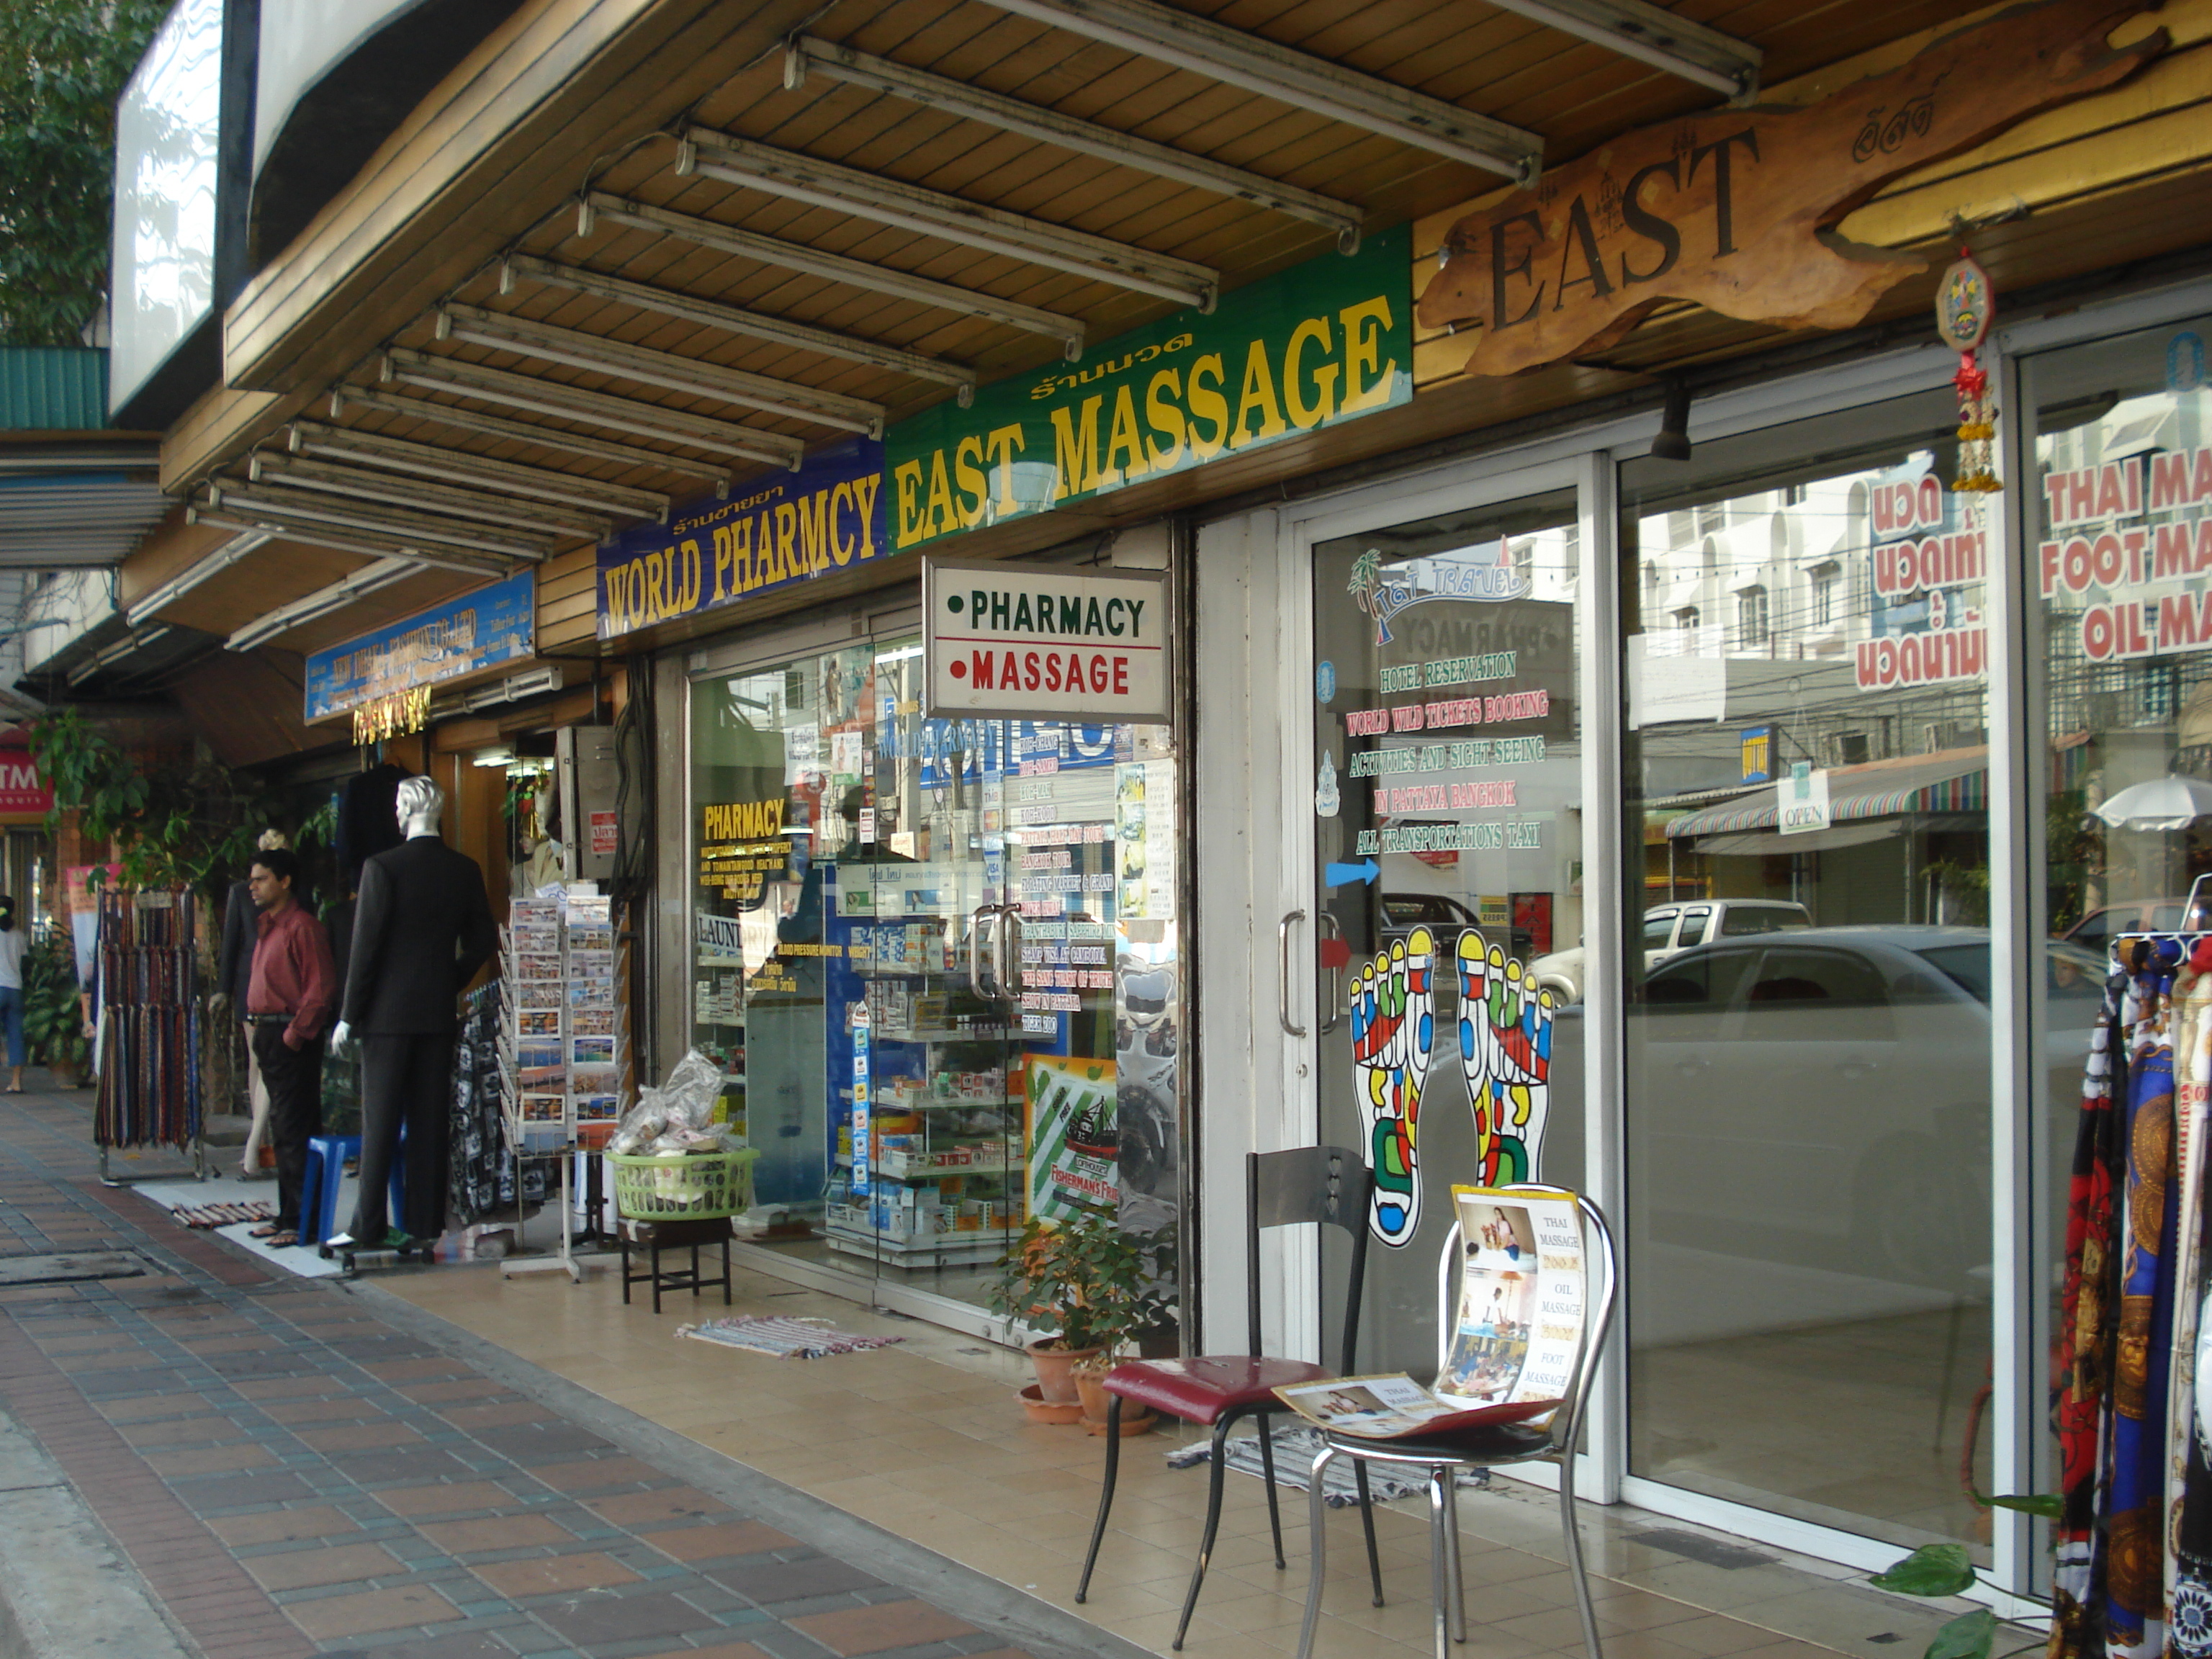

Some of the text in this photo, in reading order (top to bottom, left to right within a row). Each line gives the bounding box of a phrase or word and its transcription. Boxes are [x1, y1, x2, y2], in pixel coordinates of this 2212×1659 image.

[1489, 127, 1761, 331] EAST
[1030, 332, 1195, 401] ร้านนวด
[896, 295, 1397, 548] EAST MASSAGE
[672, 485, 784, 536] ร้านขายยา
[1873, 476, 1941, 533] นวด
[2046, 457, 2141, 527] THAI
[605, 538, 701, 639] WORLD
[713, 472, 881, 601] PHARMCY
[2040, 526, 2149, 599] FOOT
[1432, 566, 1524, 595] TRAVEL
[971, 590, 1145, 638] PHARMACY
[2082, 601, 2155, 661] OIL
[972, 649, 1129, 695] MASSAGE
[1380, 651, 1517, 694] HOTEL RESERVATION
[1346, 709, 1389, 738] WORLD
[1392, 706, 1424, 733] WILD
[1426, 696, 1483, 729] TICKETS
[1484, 689, 1550, 724] BOOKING
[1349, 735, 1546, 778] ACTIVITIES AND SIGHT SEEING
[1374, 780, 1517, 814] IN PATTAYA BANGKOK
[1786, 804, 1822, 827] OPEN
[705, 799, 785, 840] PHARMACY
[1357, 822, 1541, 855] ALL TRANSPORTATIONS TAXI
[1090, 874, 1114, 891] GRAND
[1022, 1015, 1043, 1032] TIGER
[1051, 1164, 1100, 1196] FISHERMAN'S
[1539, 1233, 1580, 1248] MASSAGE
[1544, 1217, 1568, 1228] THAI
[1541, 1301, 1581, 1316] MASSAGE
[1555, 1283, 1573, 1295] OIL
[1524, 1370, 1568, 1387] MASSAGE
[1541, 1352, 1565, 1365] FOOT
